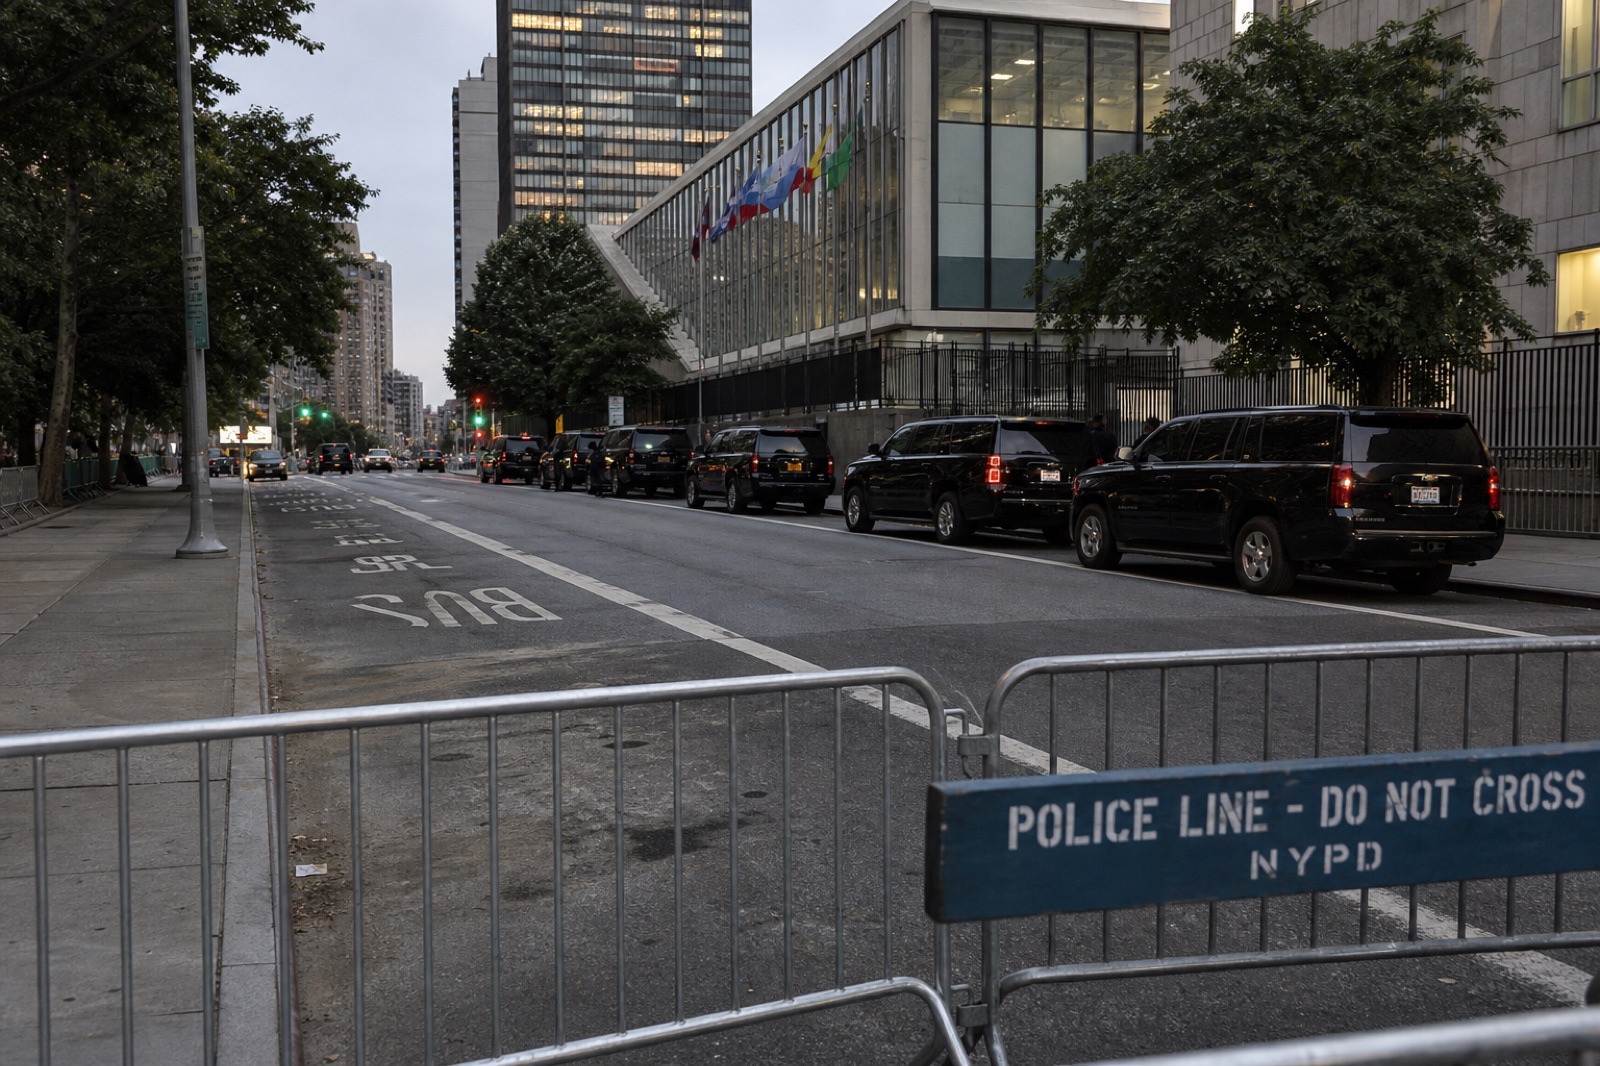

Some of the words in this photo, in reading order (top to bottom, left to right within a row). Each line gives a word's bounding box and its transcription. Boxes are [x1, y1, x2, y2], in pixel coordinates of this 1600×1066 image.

[351, 587, 563, 628] BUS
[1008, 797, 1158, 850] POLICE
[1179, 790, 1270, 838] LINE
[1320, 784, 1368, 828] DO
[1385, 777, 1456, 823] NOT
[1473, 769, 1586, 816] CROSS
[1250, 841, 1382, 880] NYPD
